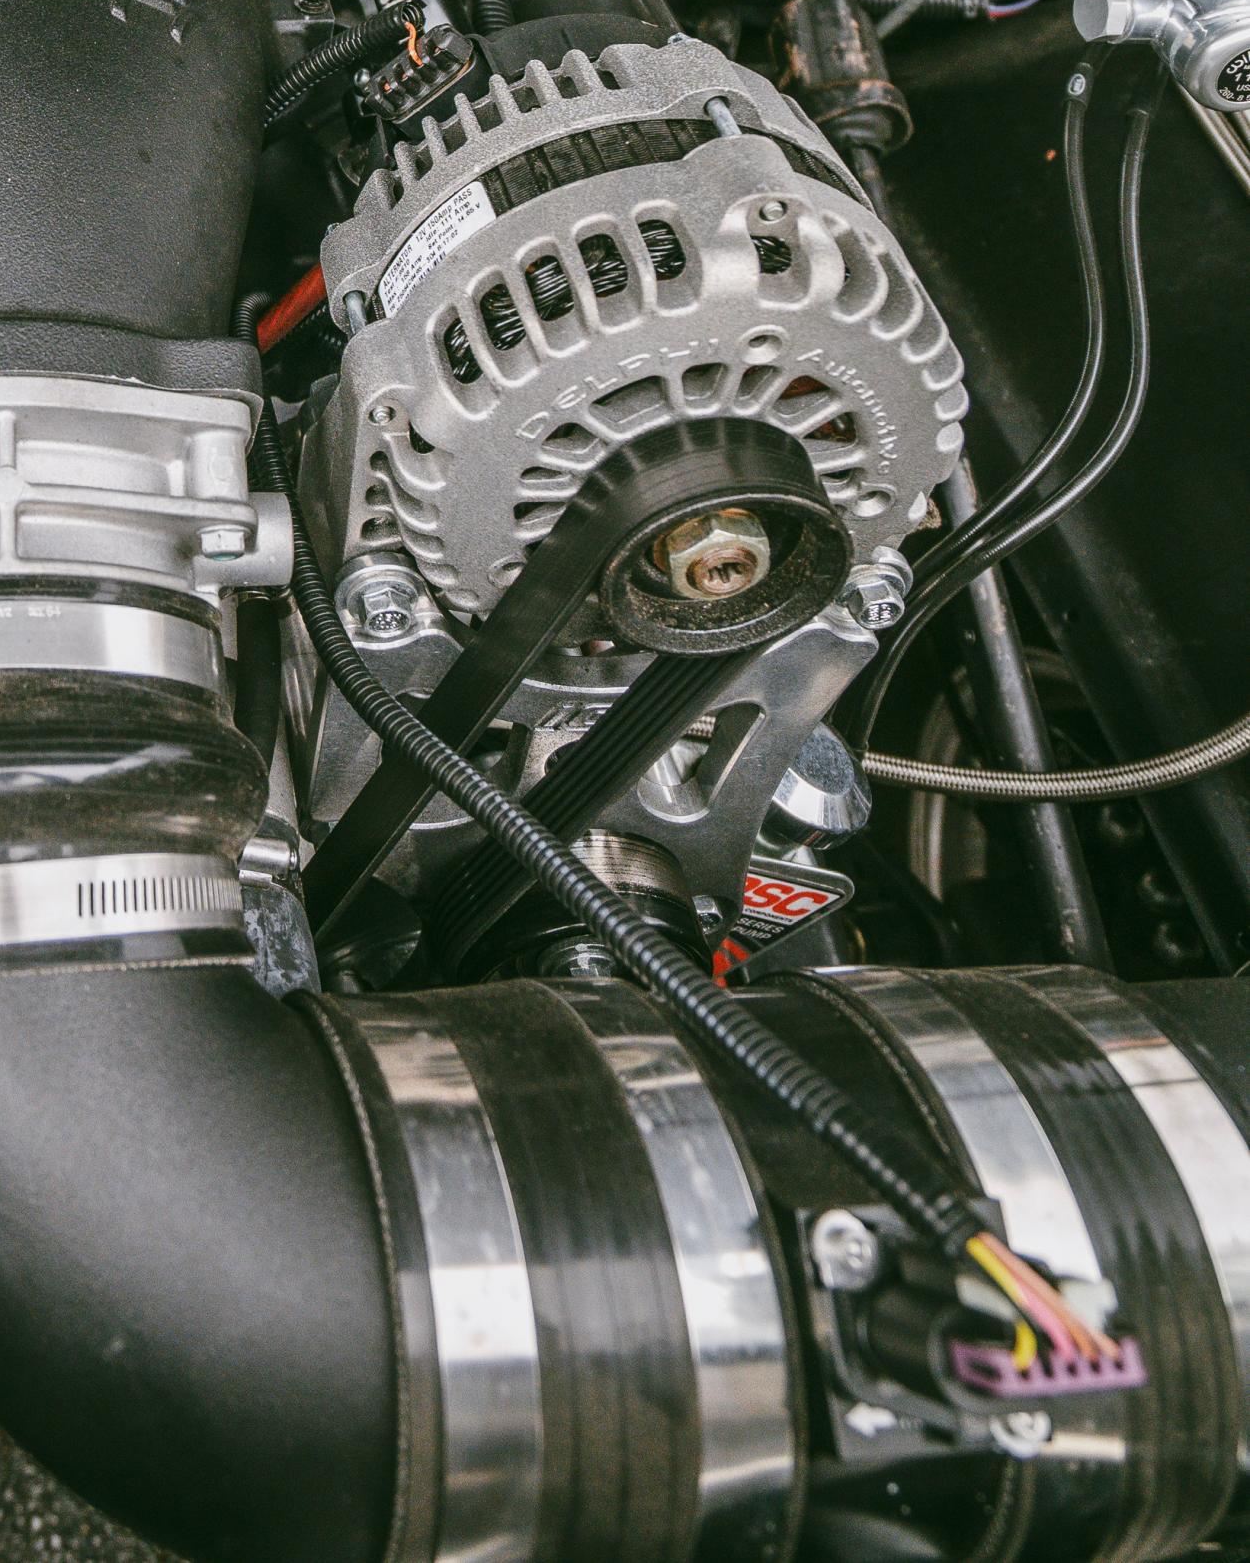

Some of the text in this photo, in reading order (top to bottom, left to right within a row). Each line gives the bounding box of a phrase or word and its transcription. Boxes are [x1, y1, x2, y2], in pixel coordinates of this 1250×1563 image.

[383, 244, 413, 289] ALTERNATOR
[454, 188, 473, 206] PASS
[514, 337, 898, 476] DELPHI Automotive
[733, 926, 772, 939] PUMP
[736, 917, 785, 934] SERIES
